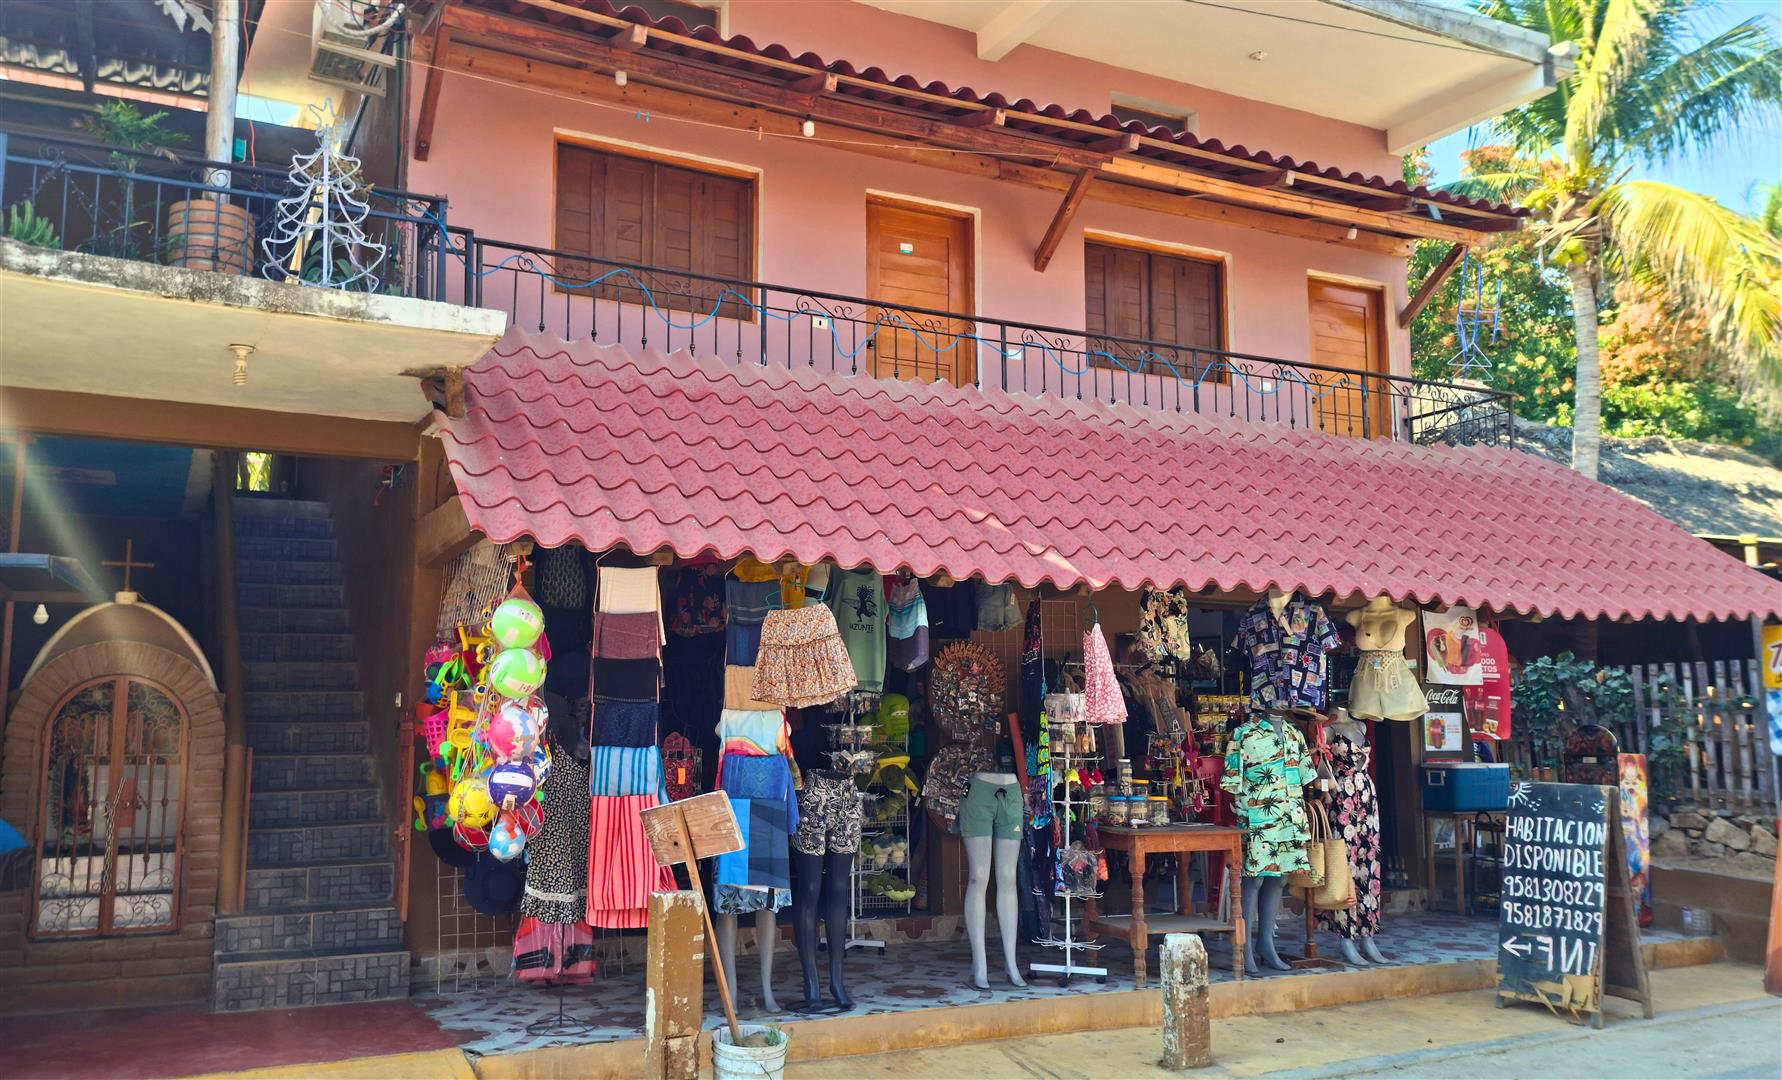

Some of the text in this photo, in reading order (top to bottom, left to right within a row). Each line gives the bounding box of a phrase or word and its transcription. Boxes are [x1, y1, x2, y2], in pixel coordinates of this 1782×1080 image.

[1505, 815, 1607, 846] HABITACION
[1504, 843, 1605, 878] DISPONIBLE
[1504, 876, 1605, 907] 9581308229
[1503, 901, 1603, 935] 9581871829
